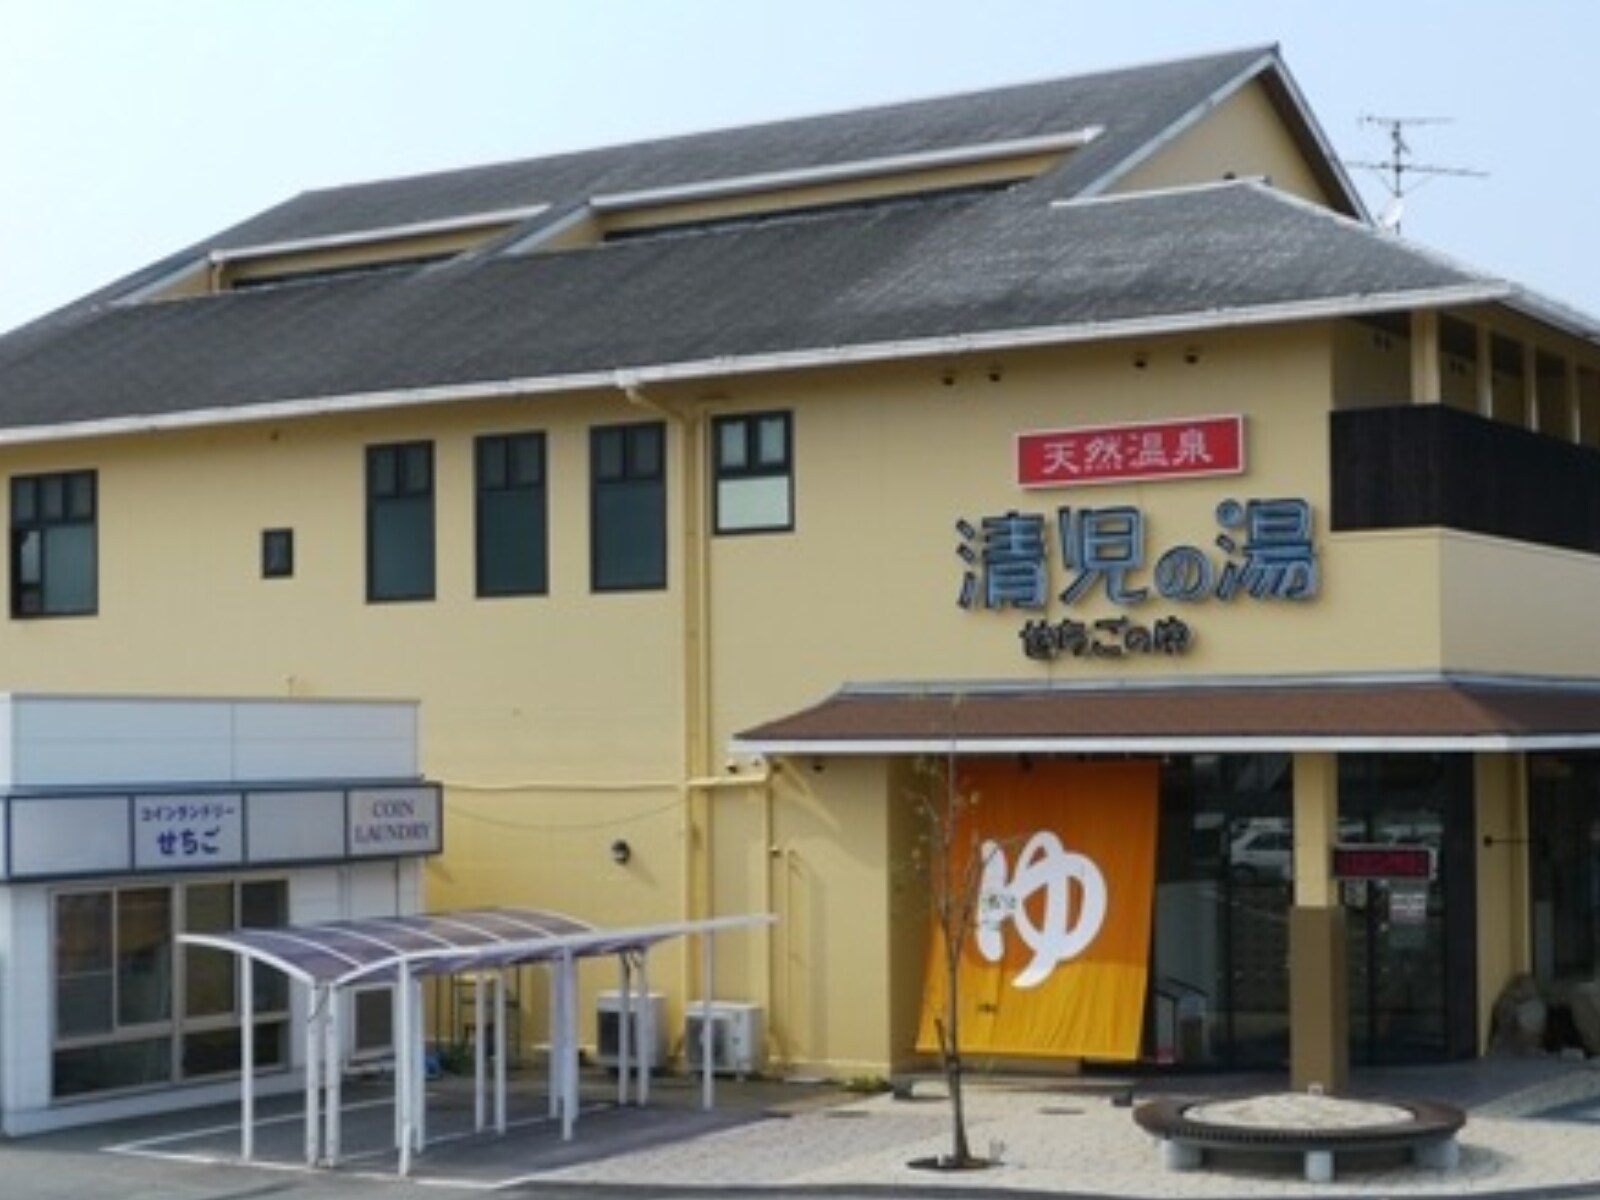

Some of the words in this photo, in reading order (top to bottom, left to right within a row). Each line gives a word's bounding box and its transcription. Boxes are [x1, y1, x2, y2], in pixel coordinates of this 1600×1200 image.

[1041, 427, 1213, 474] 天然温泉
[956, 497, 1318, 611] 清児の湯
[141, 804, 235, 821] コインランドリー
[372, 799, 415, 819] COIN
[156, 825, 220, 856] せちご
[354, 821, 430, 844] LAUNDRY
[976, 829, 1107, 990] ゆ
